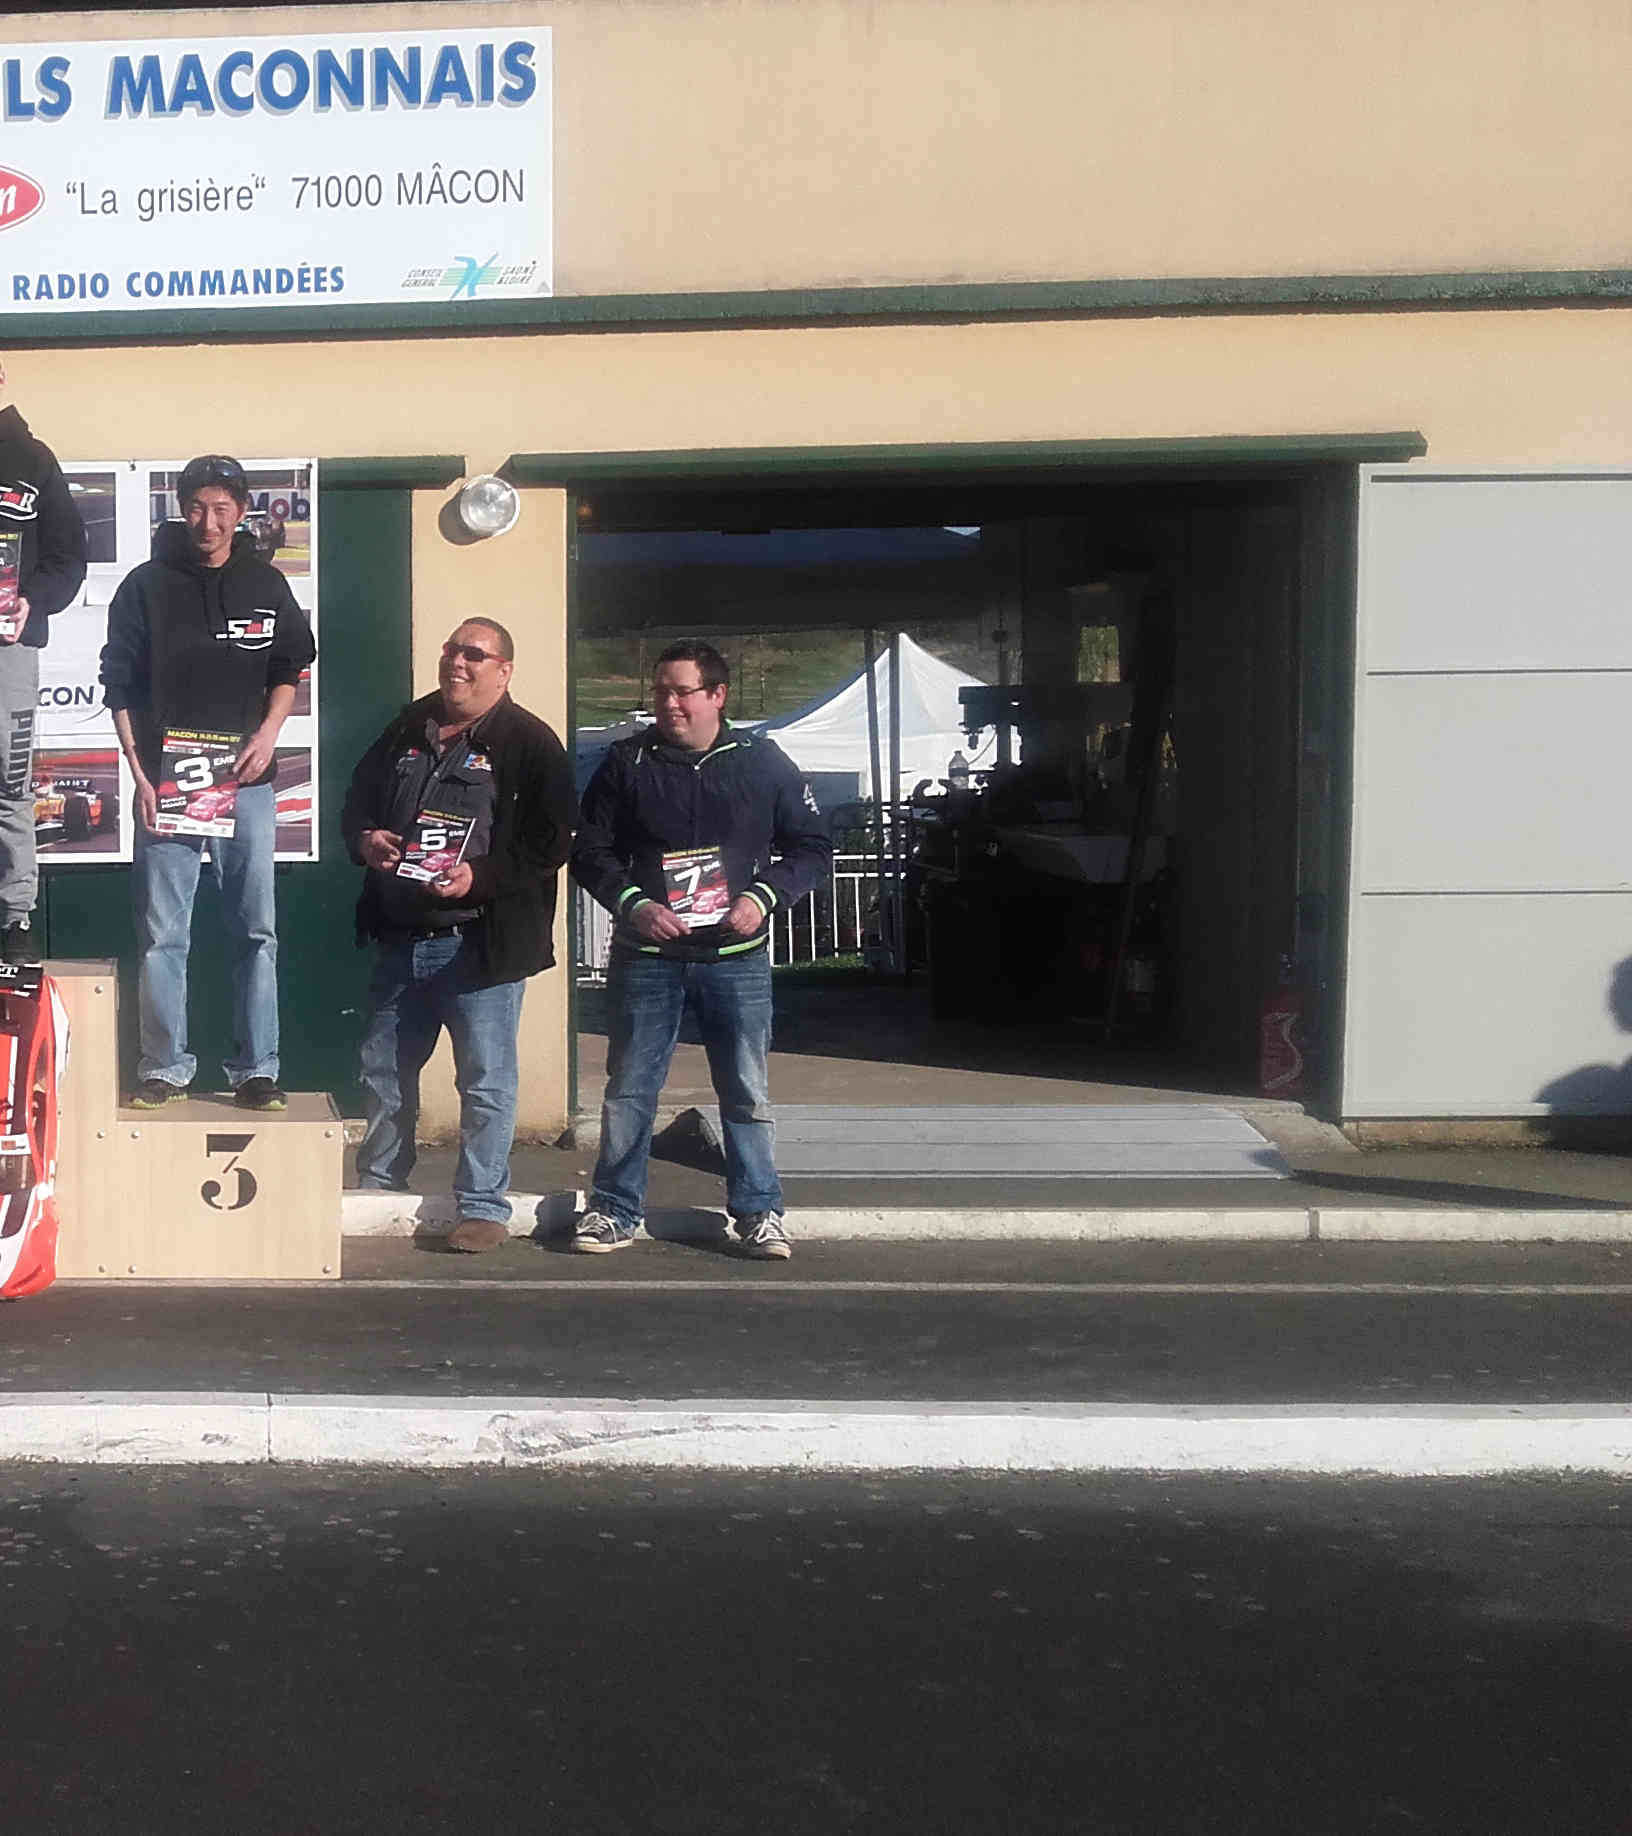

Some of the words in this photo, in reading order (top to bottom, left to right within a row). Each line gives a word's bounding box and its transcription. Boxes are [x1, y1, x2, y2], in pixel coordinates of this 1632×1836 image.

[103, 41, 537, 121] MACONNAIS
[291, 173, 383, 209] 71000
[396, 161, 526, 206] MÂCON
[12, 272, 111, 301] RADIO
[125, 261, 346, 298] COMMANDÉES
[37, 686, 96, 707] CON
[174, 756, 214, 792] 3
[419, 828, 447, 851] 5
[673, 865, 702, 896] 7
[200, 1133, 258, 1210] 3
